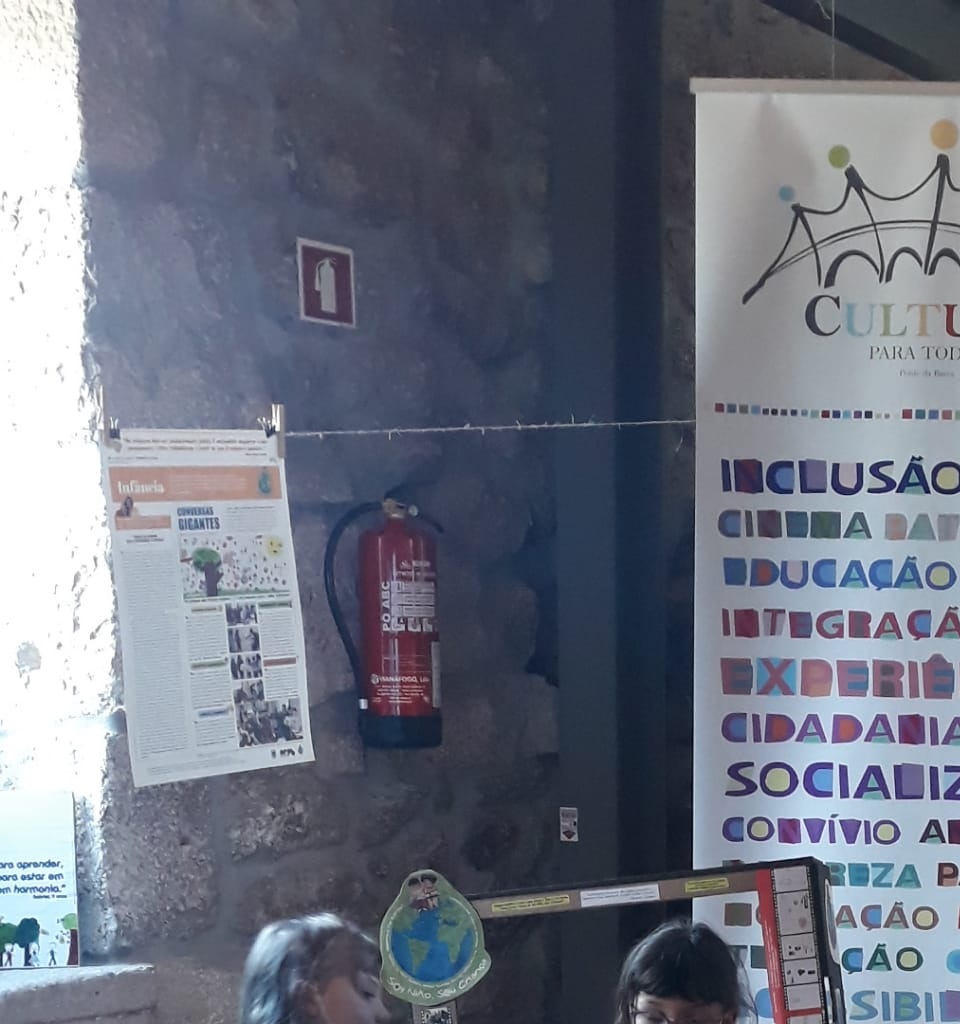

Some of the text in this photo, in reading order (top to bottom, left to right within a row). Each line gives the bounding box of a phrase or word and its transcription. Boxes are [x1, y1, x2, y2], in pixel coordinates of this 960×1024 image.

[869, 345, 916, 362] PARA
[118, 480, 165, 494] Infância
[178, 517, 221, 531] GIGANTES
[717, 509, 873, 540] CINEMA
[723, 555, 958, 592] EDUCAÇÃO
[381, 581, 391, 632] PO ABC
[722, 813, 901, 846] CONVÍVIO
[0, 859, 64, 870] ara aprender,
[0, 873, 18, 881] ara
[20, 872, 45, 880] estar
